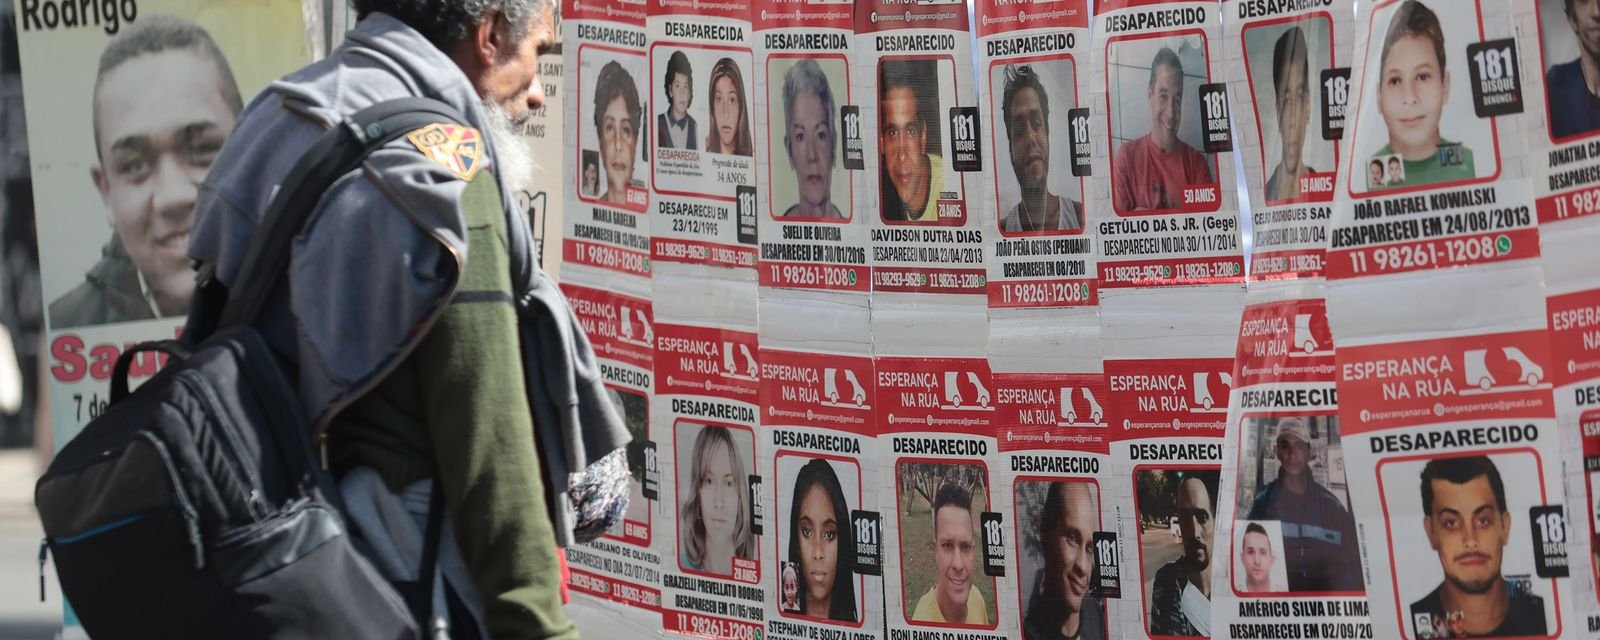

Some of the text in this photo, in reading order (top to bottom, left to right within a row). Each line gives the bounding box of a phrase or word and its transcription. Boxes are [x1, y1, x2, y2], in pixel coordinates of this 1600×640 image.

[1105, 6, 1206, 33] DESAPARECIDO
[665, 21, 744, 42] DESAPARECIDA
[765, 33, 848, 50] DESAPARECIDA
[876, 34, 955, 52] DESAPARECIDO
[987, 33, 1076, 57] DESAPARECIDO
[1473, 47, 1514, 81] 181
[1481, 77, 1515, 93] DISQUE
[1204, 92, 1227, 119] 181
[953, 115, 975, 140] 181
[1309, 177, 1332, 192] ANOS
[1195, 187, 1216, 203] ANOS
[1354, 187, 1497, 220] JOÃO RAFAEL KOWALSKI
[659, 202, 728, 221] DESAPARECEU EM
[1555, 197, 1568, 219] 11
[673, 219, 718, 236] 23/12/1995
[783, 225, 802, 240] SUELI
[804, 226, 813, 240] DE
[1153, 215, 1238, 233] DA S. JR. (Gege)
[1332, 206, 1530, 248] DESAPARECEU EM 24/08/2013
[871, 228, 983, 244] DAVIDSON DUTRA DIAS
[1104, 235, 1237, 256] DESAPARECEU NO DIA 30/11/2014
[761, 243, 812, 261] DESAPARECEU
[813, 246, 823, 261] EM
[919, 247, 927, 262] NO
[928, 248, 939, 262] DIA
[1350, 237, 1494, 273] 11 98261-1208
[771, 265, 849, 286] 11 98261-1208
[1003, 260, 1086, 278] DESAPARECEU EM 08/2018
[1002, 283, 1080, 303] 11 98261-1208
[1242, 317, 1288, 338] ESPERANÇA
[658, 336, 719, 360] ESPERANÇA
[1254, 341, 1265, 357] NA
[680, 357, 694, 373] NA
[762, 363, 819, 387] ESPERANÇA
[1343, 355, 1453, 381] ESPERANÇA
[782, 385, 797, 401] NA
[879, 372, 939, 394] ESPERANÇA
[1110, 374, 1186, 395] ESPERANÇA
[1382, 382, 1411, 401] NA
[73, 394, 83, 421] 7
[901, 393, 916, 408] NA
[998, 388, 1055, 409] ESPERANÇA
[1138, 396, 1158, 412] NA
[672, 398, 755, 423] DESAPARECIDA
[1019, 409, 1034, 424] NA
[774, 430, 861, 454] DESAPARECIDA
[893, 437, 987, 456] DESAPARECIDO
[1370, 424, 1539, 453] DESAPARECIDO
[1011, 455, 1099, 474] DESAPARECIDO
[855, 518, 877, 545] 181
[623, 548, 631, 558] DE
[1096, 540, 1117, 566] 181
[613, 562, 623, 575] DIA
[675, 594, 717, 613] DESAPARECEU
[718, 602, 728, 615] EM
[1239, 599, 1370, 618] AMÉRICO SILVA DE LIMA
[677, 614, 753, 640] 11 98261-1208
[769, 620, 807, 638] STEPHANY
[809, 627, 818, 639] DE
[1230, 623, 1300, 639] DESAPARECEU
[1304, 623, 1320, 639] EM
